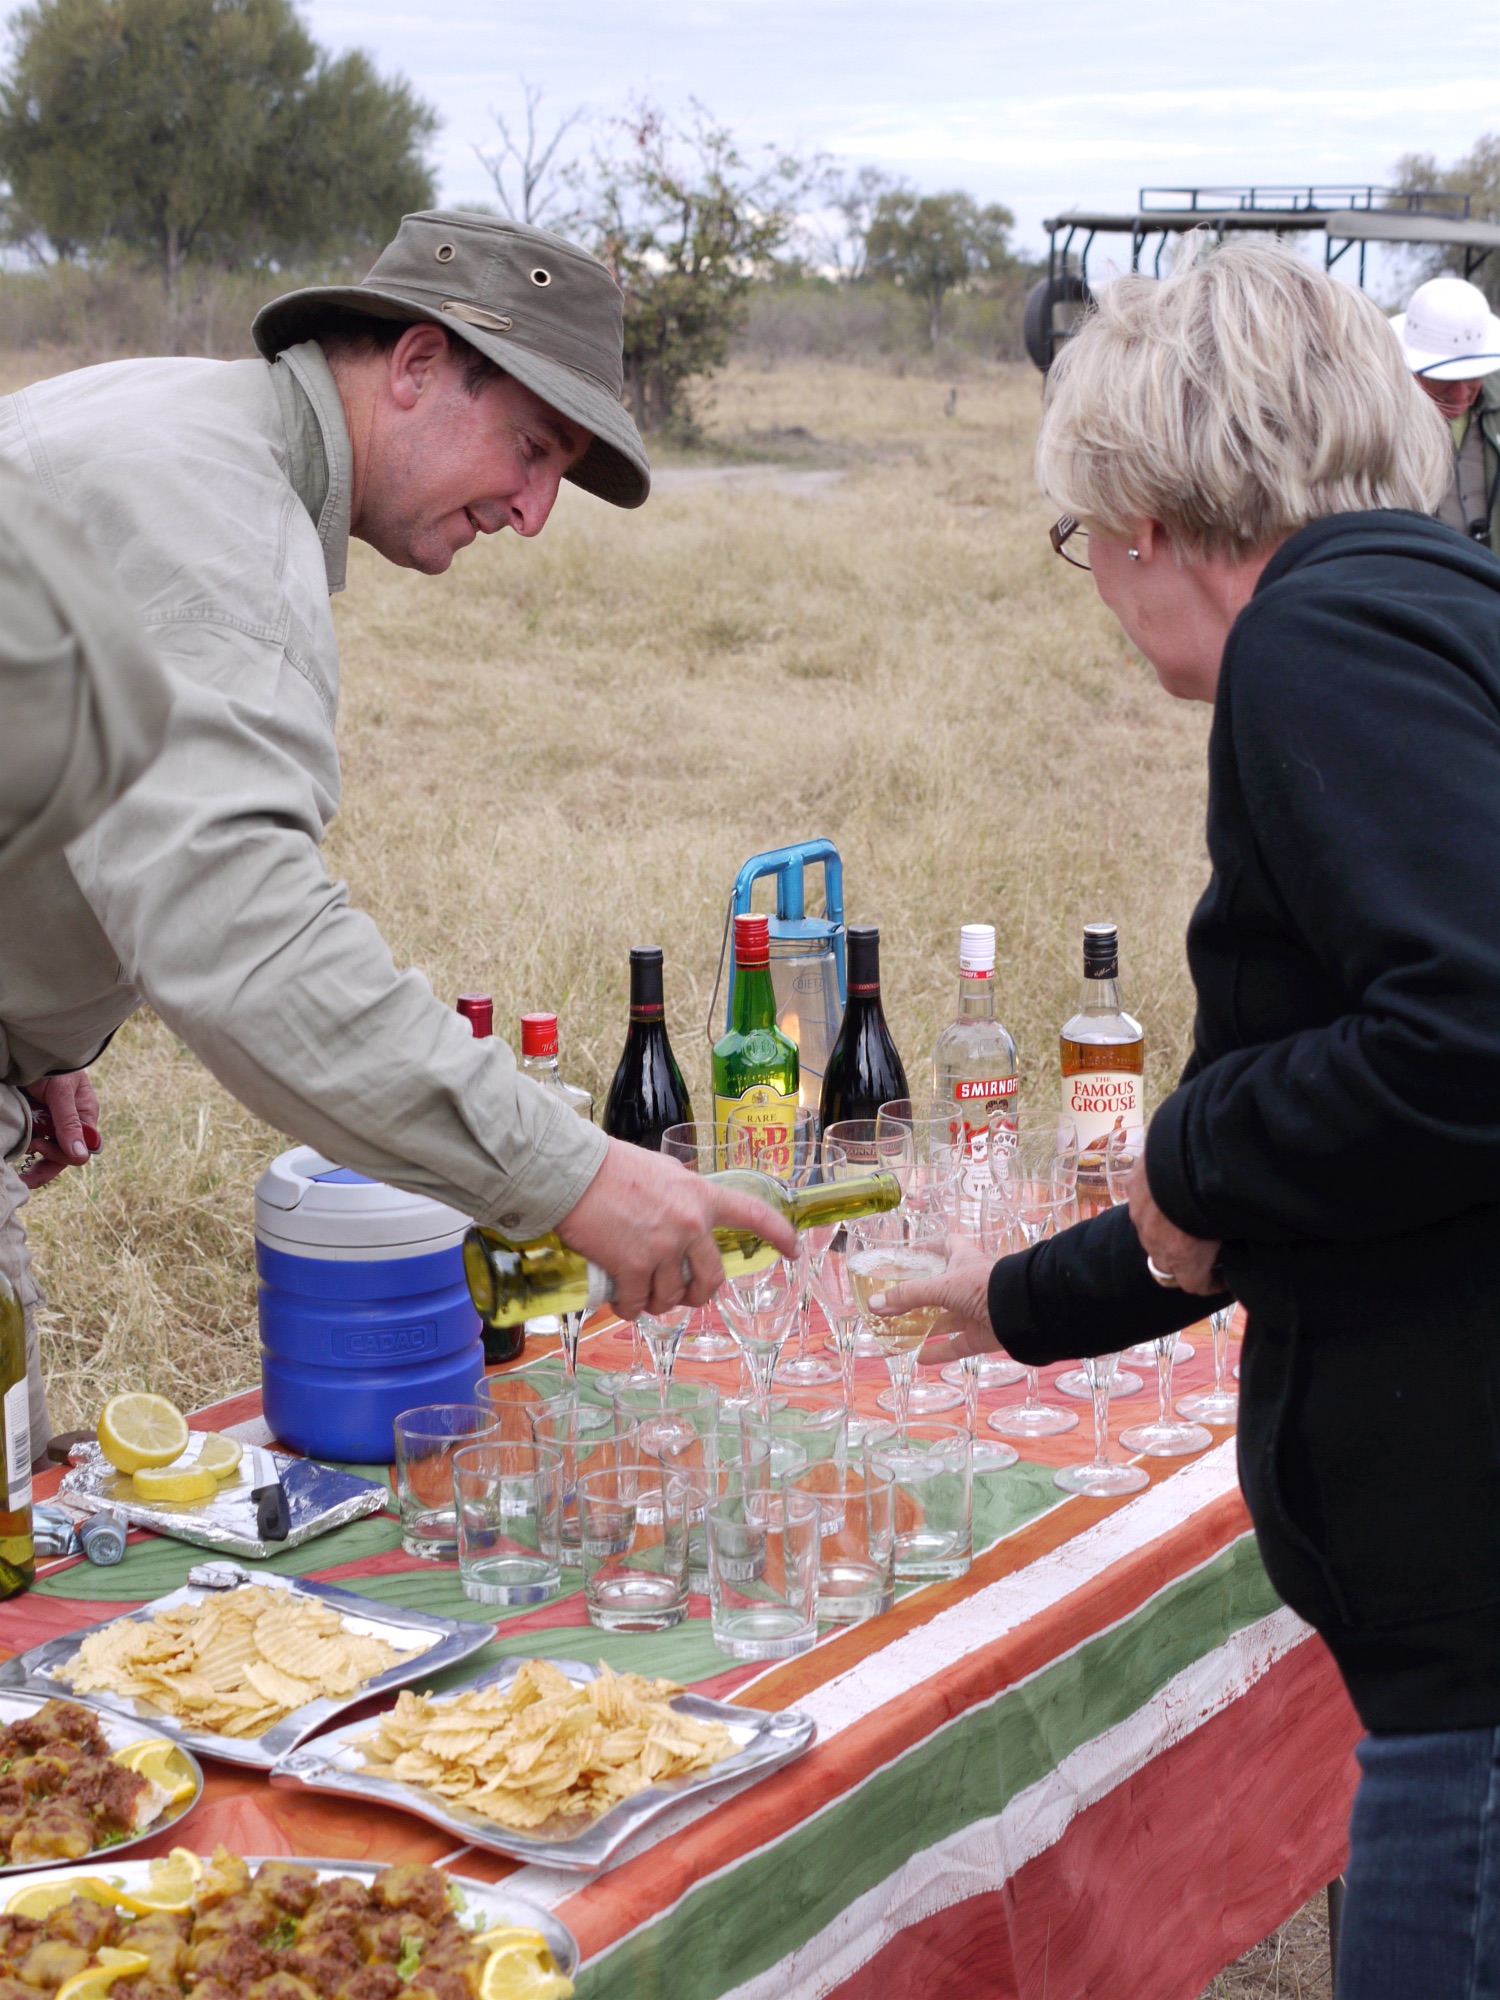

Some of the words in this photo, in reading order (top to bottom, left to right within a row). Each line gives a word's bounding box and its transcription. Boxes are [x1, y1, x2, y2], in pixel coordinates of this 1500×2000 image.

[1073, 1080, 1134, 1097] FAMOUS
[1071, 1095, 1136, 1113] GROUSE
[747, 1113, 777, 1123] RARE
[350, 1330, 423, 1351] CADAC
